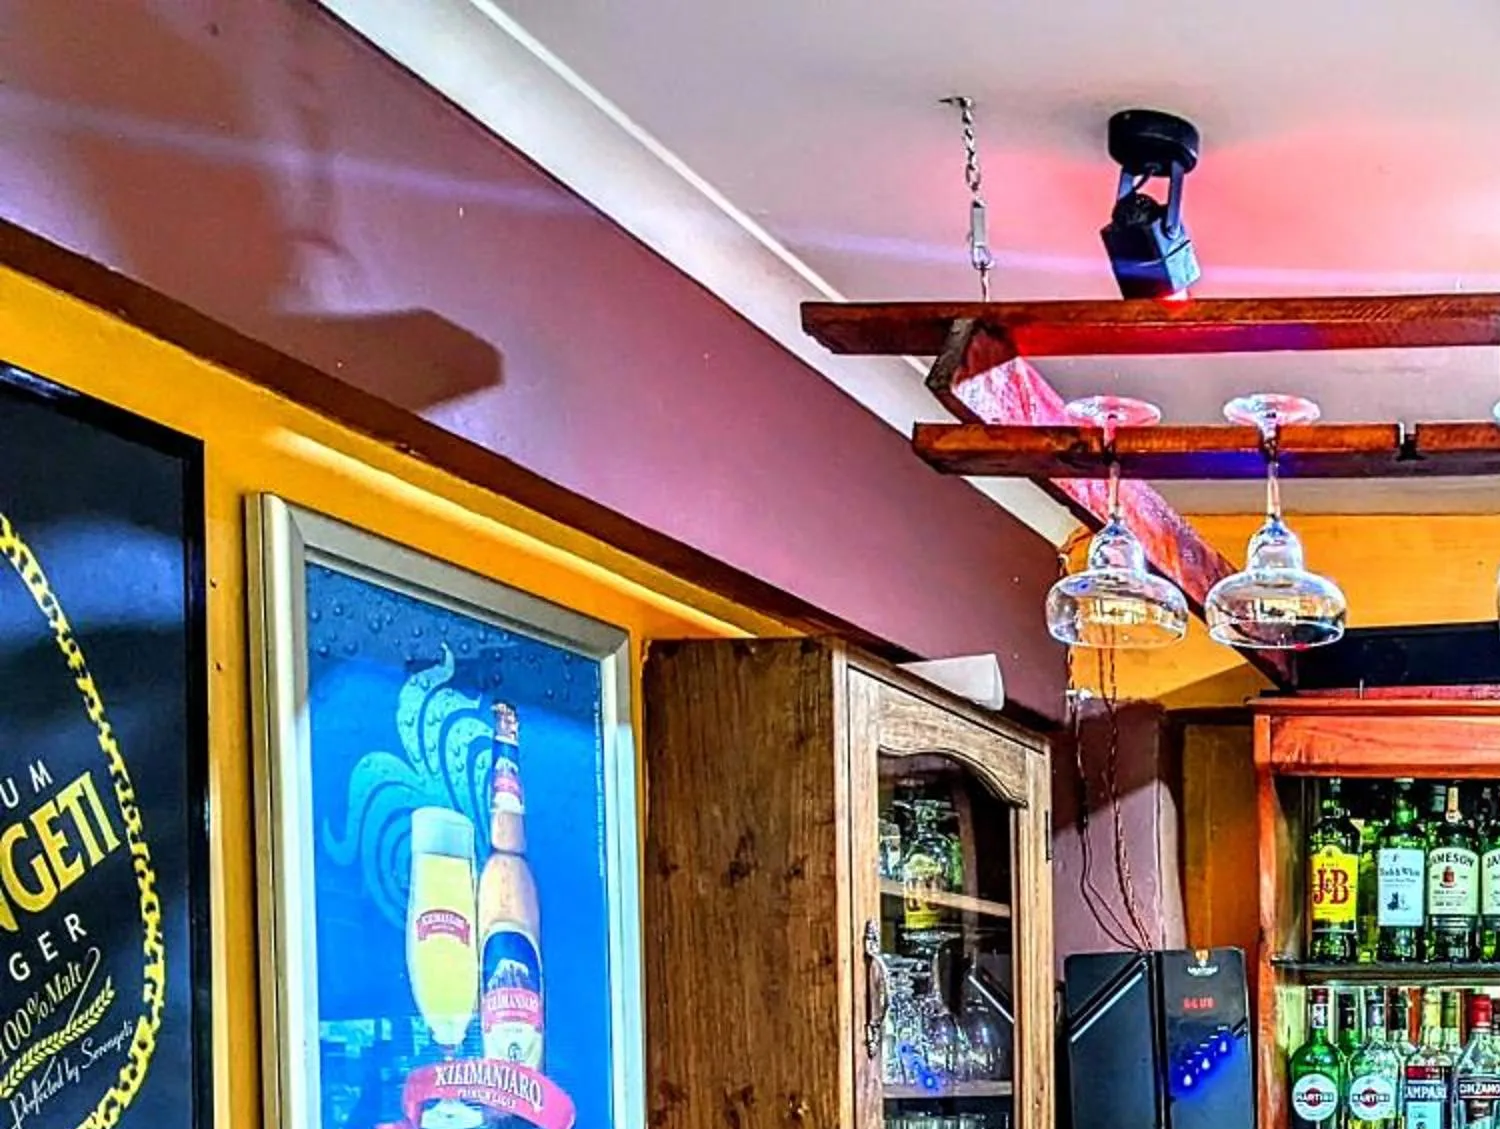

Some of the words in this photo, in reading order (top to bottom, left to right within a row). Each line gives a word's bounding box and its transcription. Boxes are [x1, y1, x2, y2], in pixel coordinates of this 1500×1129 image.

[0, 771, 121, 931] GETI
[45, 961, 83, 1013] Malt
[64, 1056, 80, 1084] by
[435, 1061, 543, 1112] KILIMANJARO
